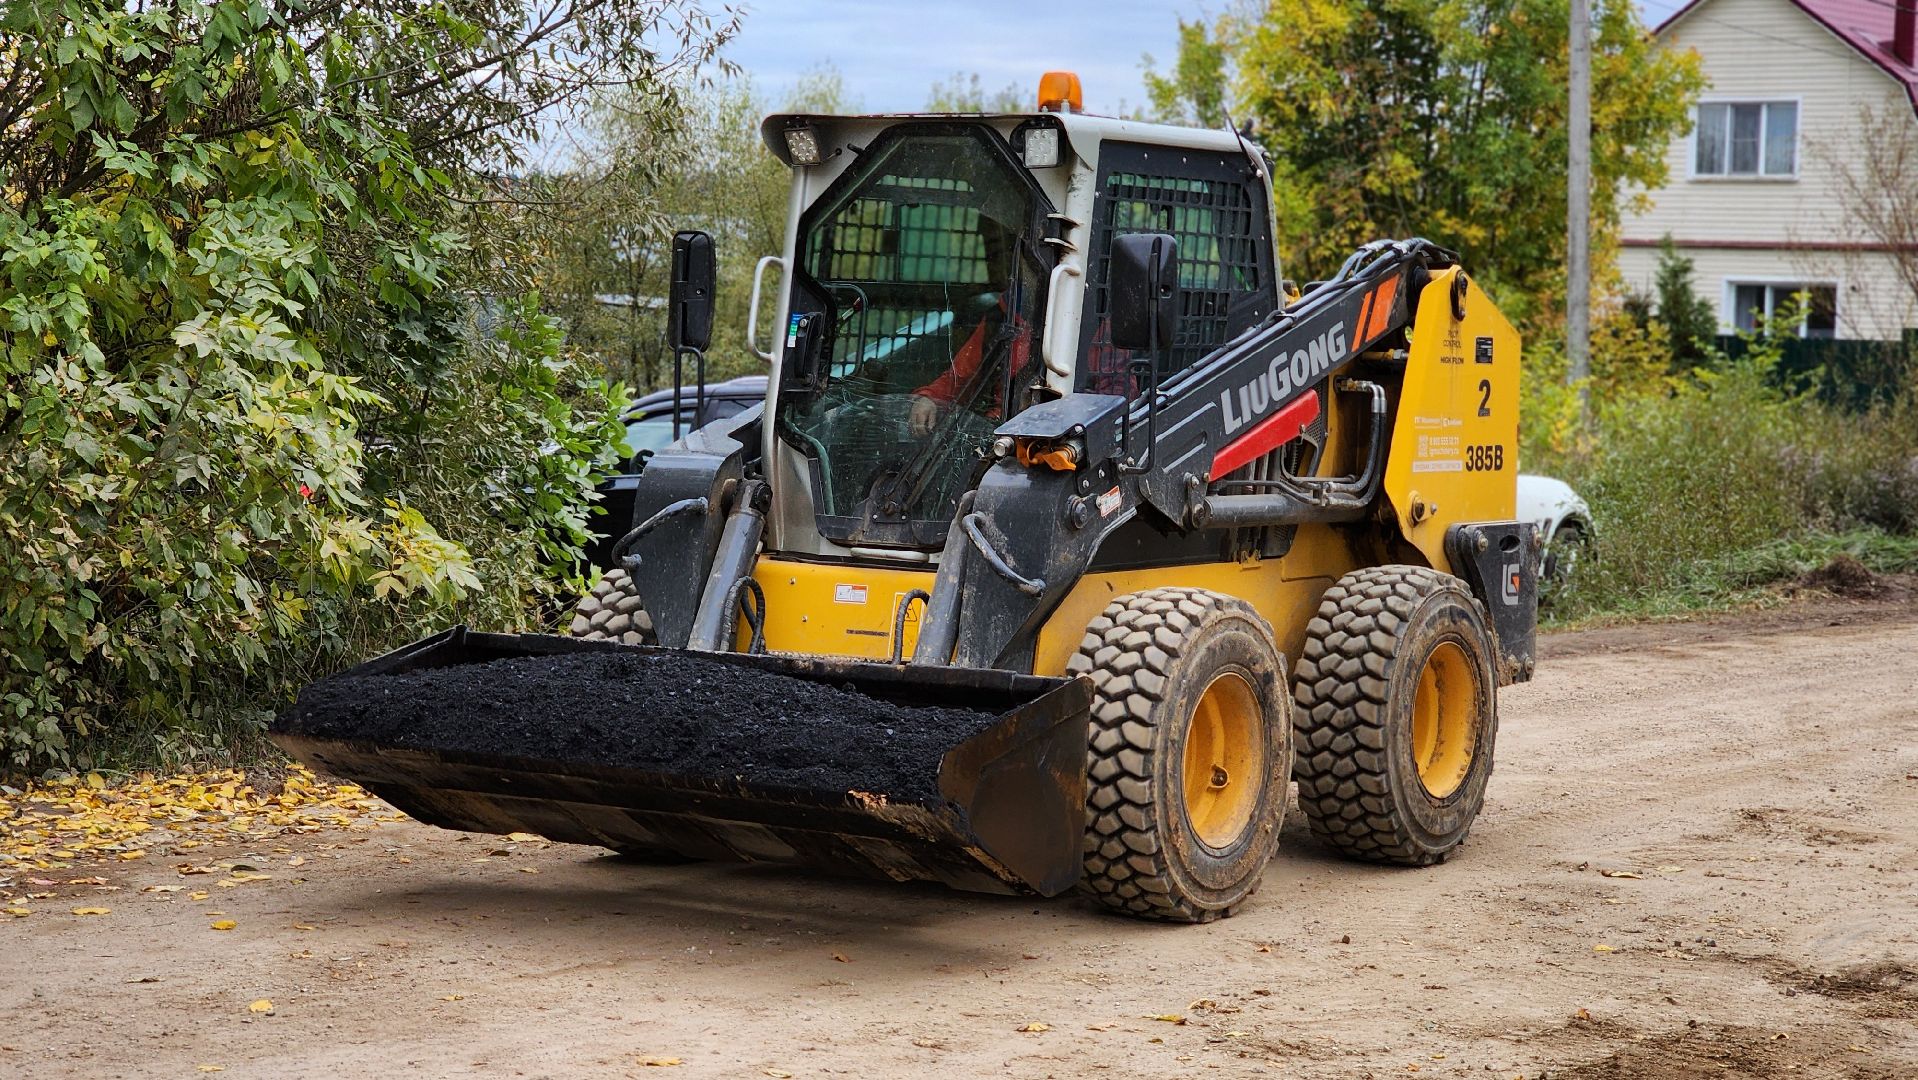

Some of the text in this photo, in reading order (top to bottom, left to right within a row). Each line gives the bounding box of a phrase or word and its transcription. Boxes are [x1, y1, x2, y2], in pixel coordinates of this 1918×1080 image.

[1440, 356, 1451, 364] HIGH
[1478, 379, 1491, 417] 2
[1465, 445, 1503, 472] 385B
